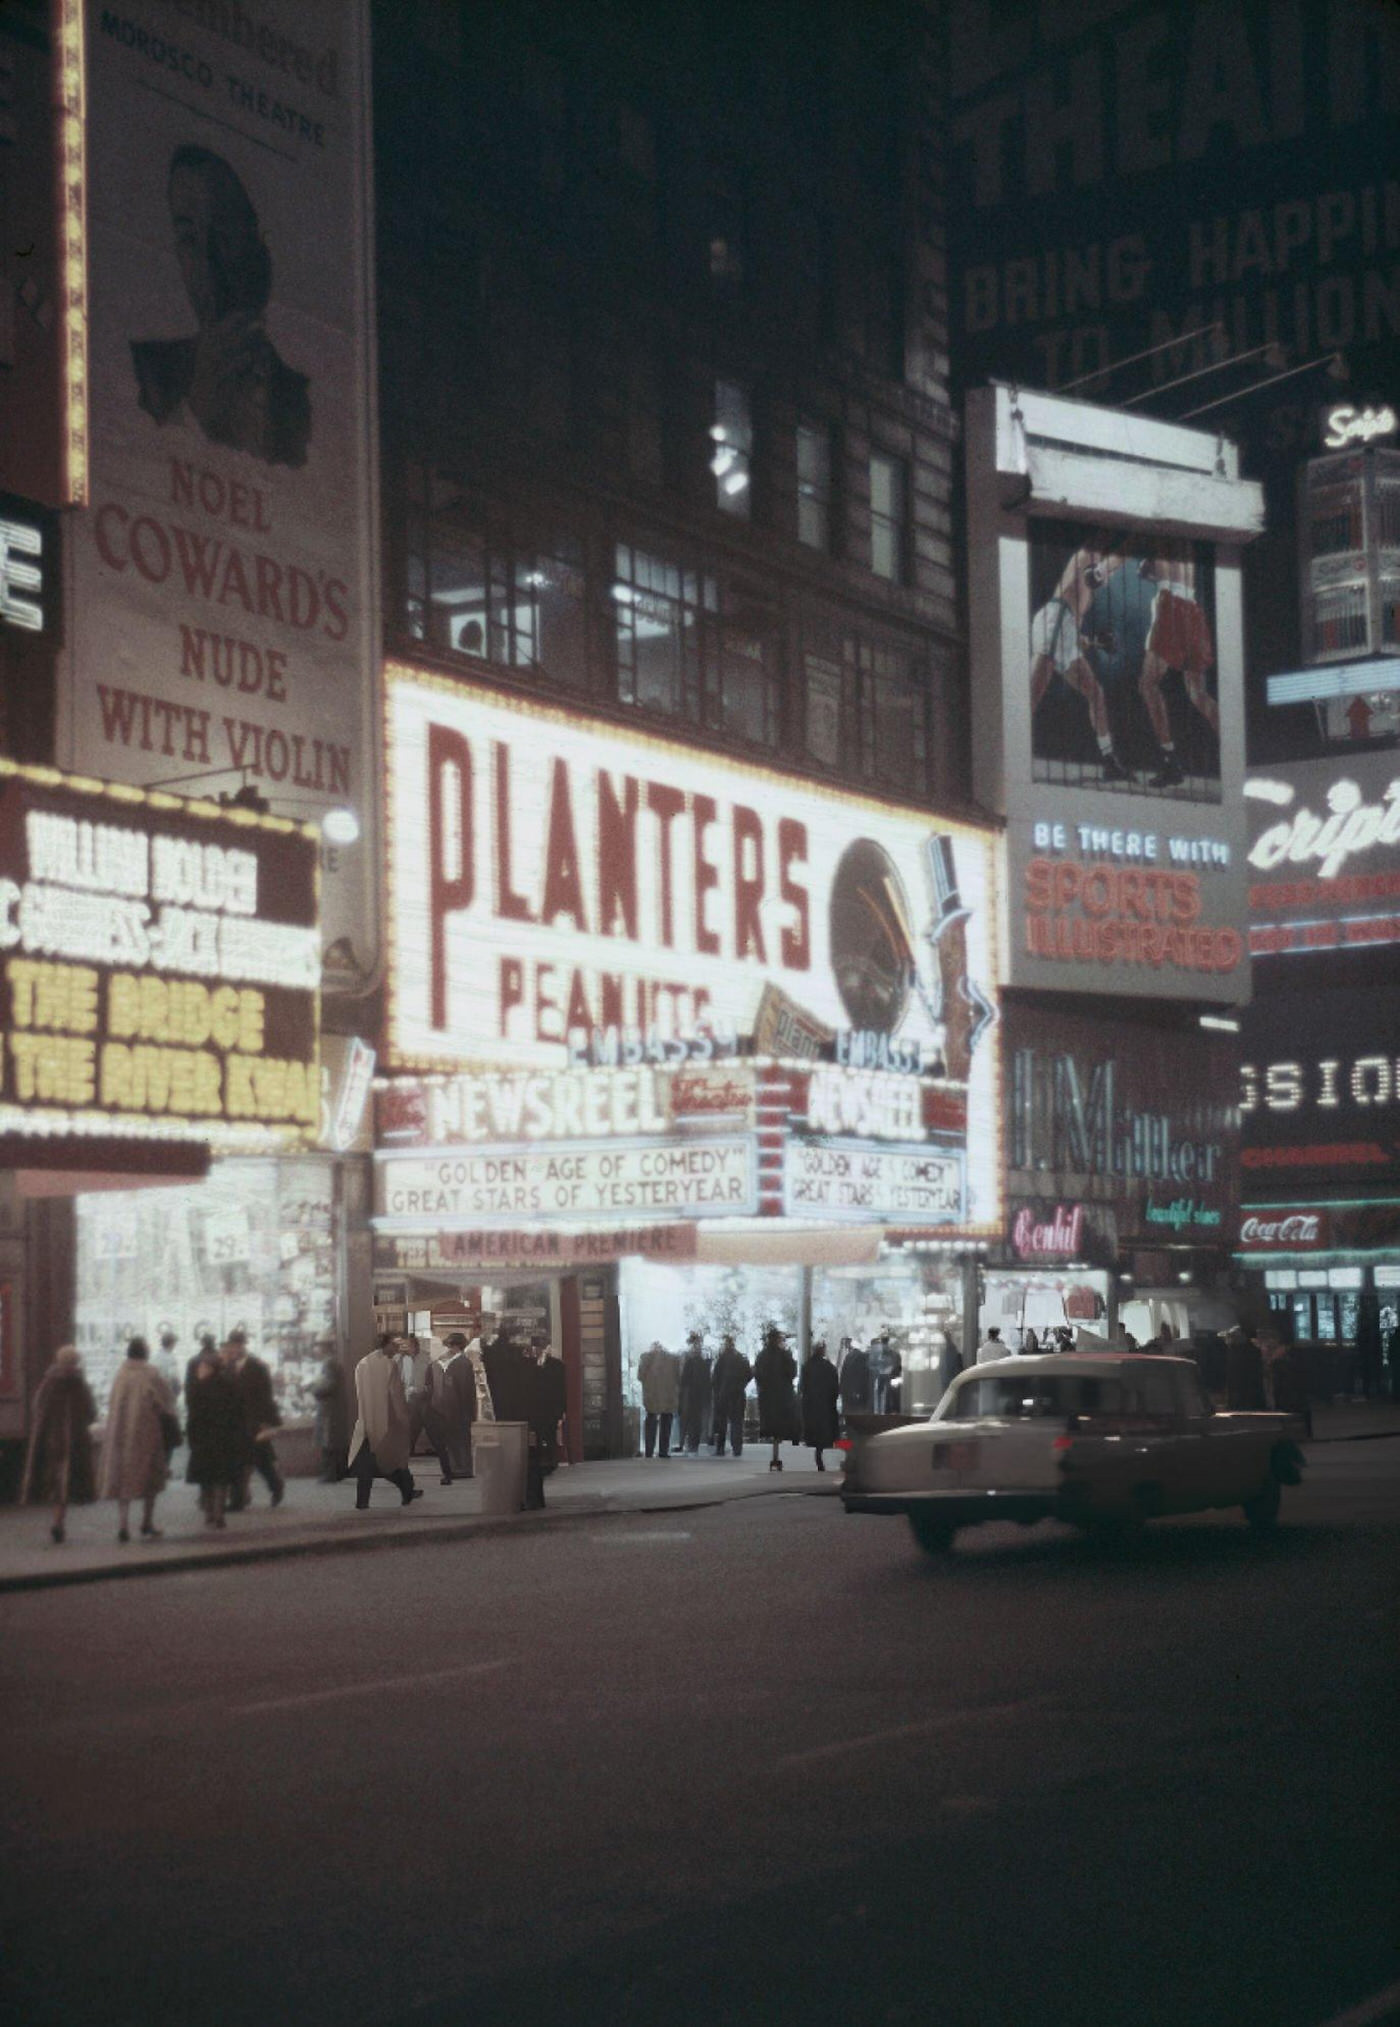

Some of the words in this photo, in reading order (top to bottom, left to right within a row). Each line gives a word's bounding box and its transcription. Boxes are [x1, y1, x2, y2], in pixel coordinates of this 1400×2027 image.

[226, 76, 327, 148] THEATRE
[962, 233, 1152, 334] BRING
[169, 456, 271, 536] NOEL
[94, 502, 349, 642] COWARD'S
[178, 623, 289, 703] NUDE
[96, 683, 211, 765] WITH
[222, 716, 350, 794] VIOLIN
[426, 720, 812, 1032] PLANTERS
[1033, 821, 1066, 849] BE
[1077, 824, 1158, 858] THERE
[1168, 836, 1230, 865] WITH
[1026, 859, 1201, 923] SPORTS
[1027, 915, 1243, 971] ILLUSTRATED
[429, 1069, 668, 1141] NEWSREEL
[1239, 1057, 1400, 1109] SIO
[391, 1188, 462, 1213] GREAT
[472, 1183, 542, 1211] STARS
[554, 1183, 580, 1208] OF
[593, 1175, 744, 1207] YESTERYEAR
[544, 1155, 587, 1183] AGE
[599, 1152, 626, 1178] OF
[454, 1230, 560, 1256] AMERICAN
[573, 1224, 677, 1256] PREMIERE
[1240, 1214, 1320, 1242] Coca-Cola
